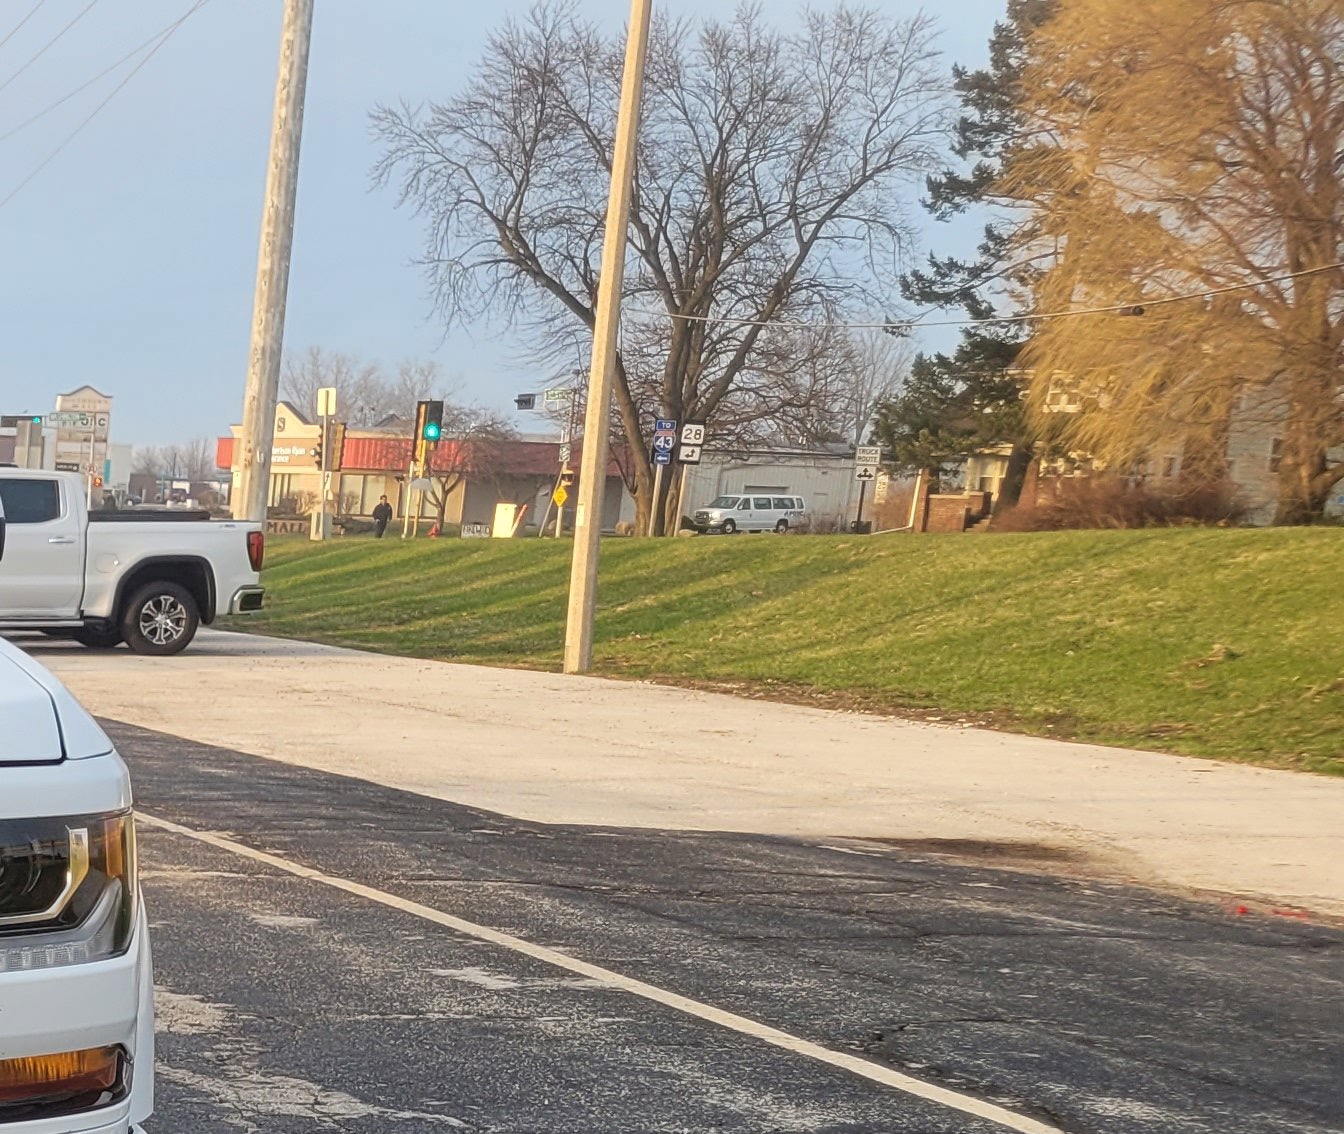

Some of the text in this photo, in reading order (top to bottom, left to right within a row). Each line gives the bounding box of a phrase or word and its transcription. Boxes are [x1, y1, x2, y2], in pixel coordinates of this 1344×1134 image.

[684, 428, 702, 440] 28
[656, 436, 673, 449] 43
[857, 455, 878, 463] ROUTE
